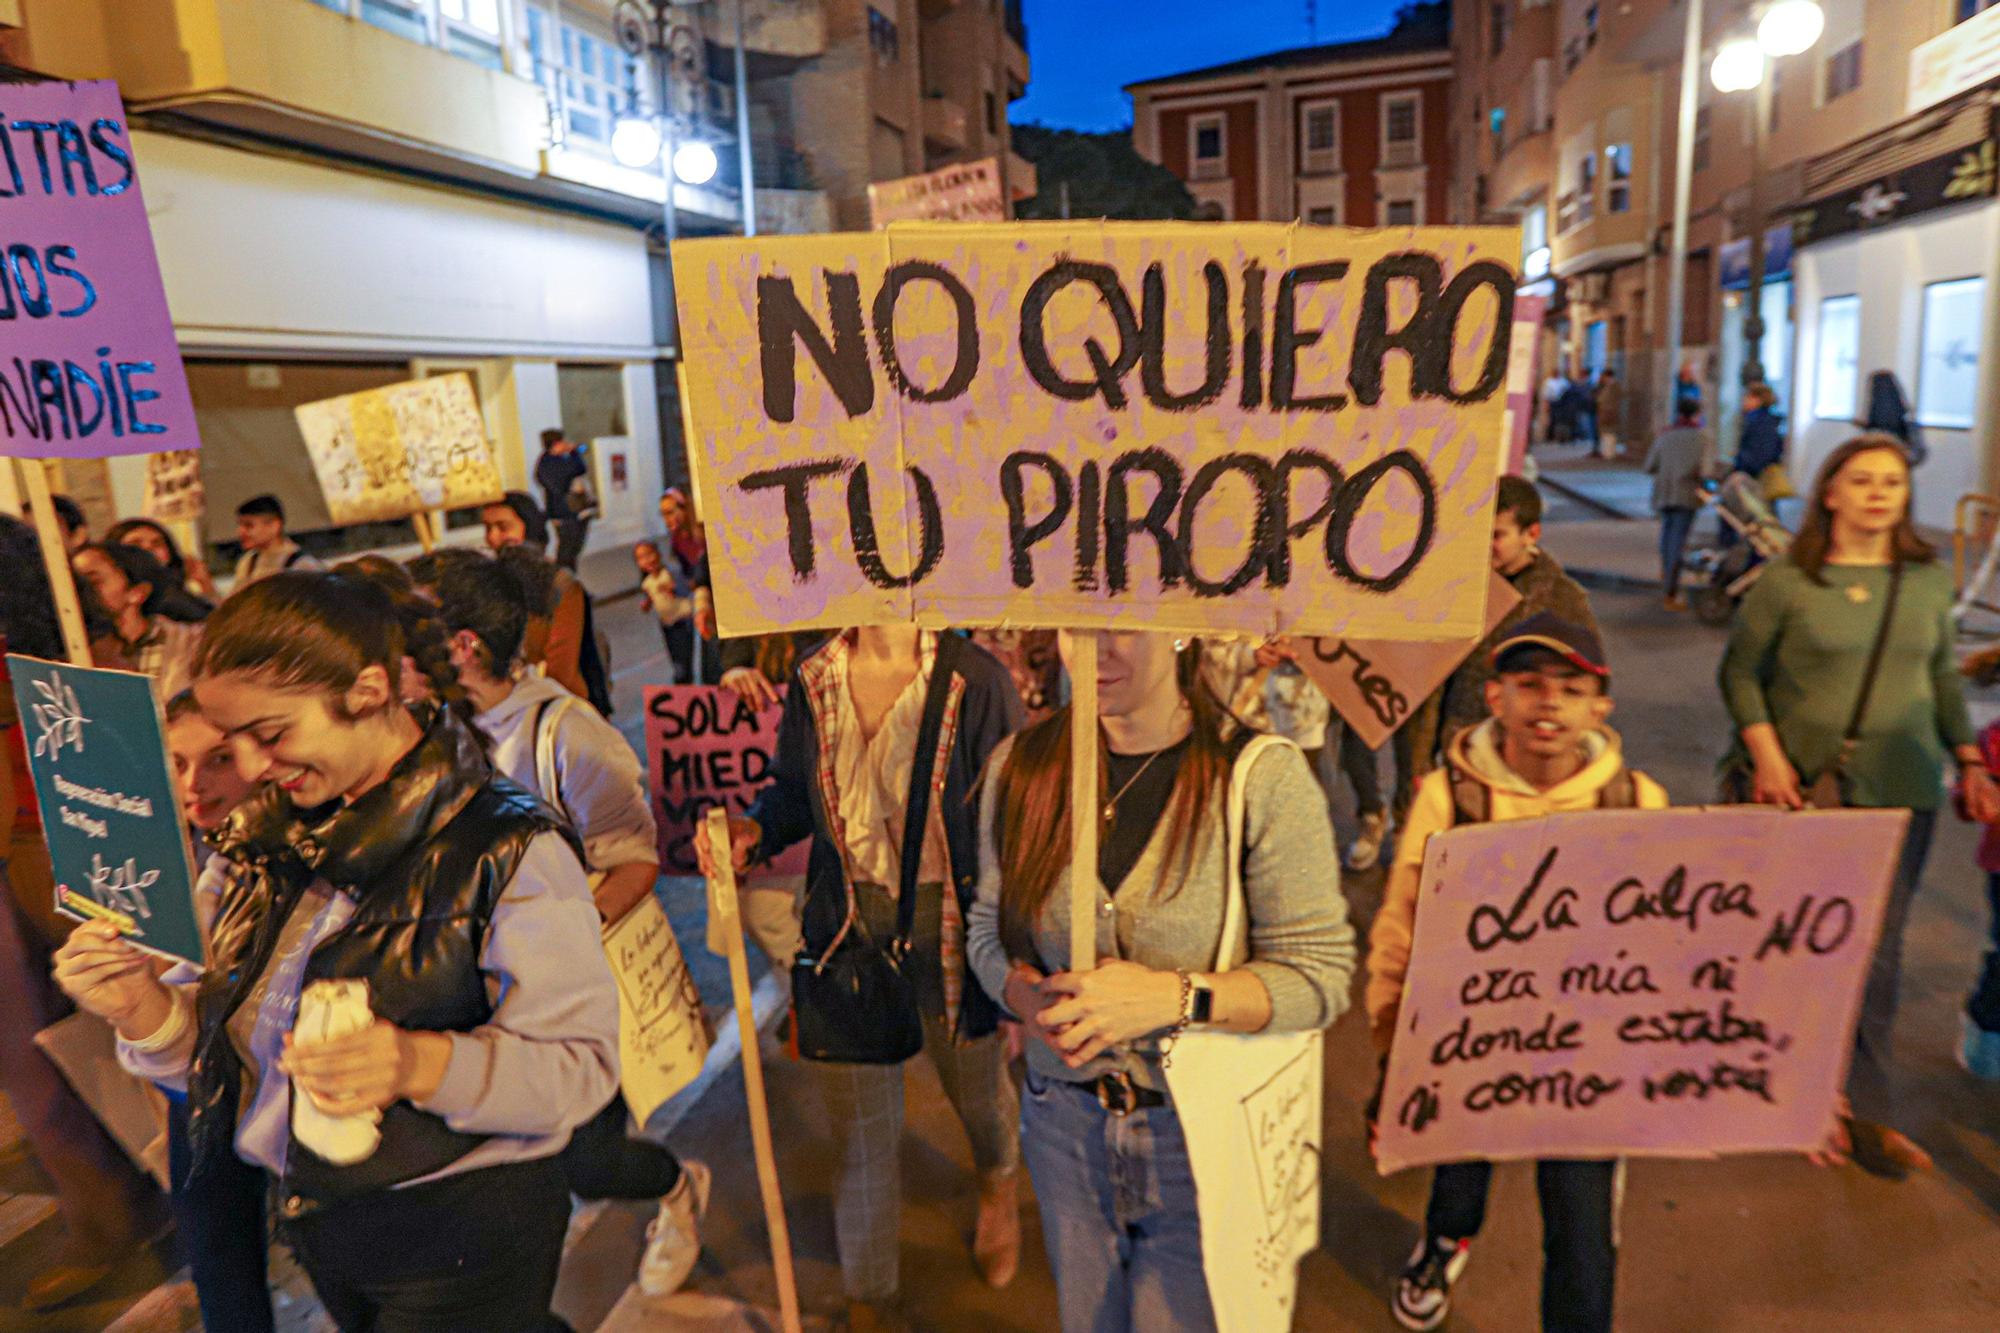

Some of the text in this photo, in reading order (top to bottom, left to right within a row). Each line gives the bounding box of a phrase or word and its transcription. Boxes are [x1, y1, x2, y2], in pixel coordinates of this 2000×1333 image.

[757, 250, 1516, 422] NO QUIERO
[738, 445, 1436, 597] TU PIROPO
[650, 690, 759, 739] SOLA
[661, 747, 776, 791] MIED
[1467, 846, 1579, 952] La
[1754, 894, 1855, 962] NO
[1459, 965, 1540, 1006] era
[1691, 956, 1739, 994] ni
[1430, 1013, 1585, 1067] donde
[1399, 1081, 1441, 1134] ni
[1463, 1069, 1625, 1115] como
